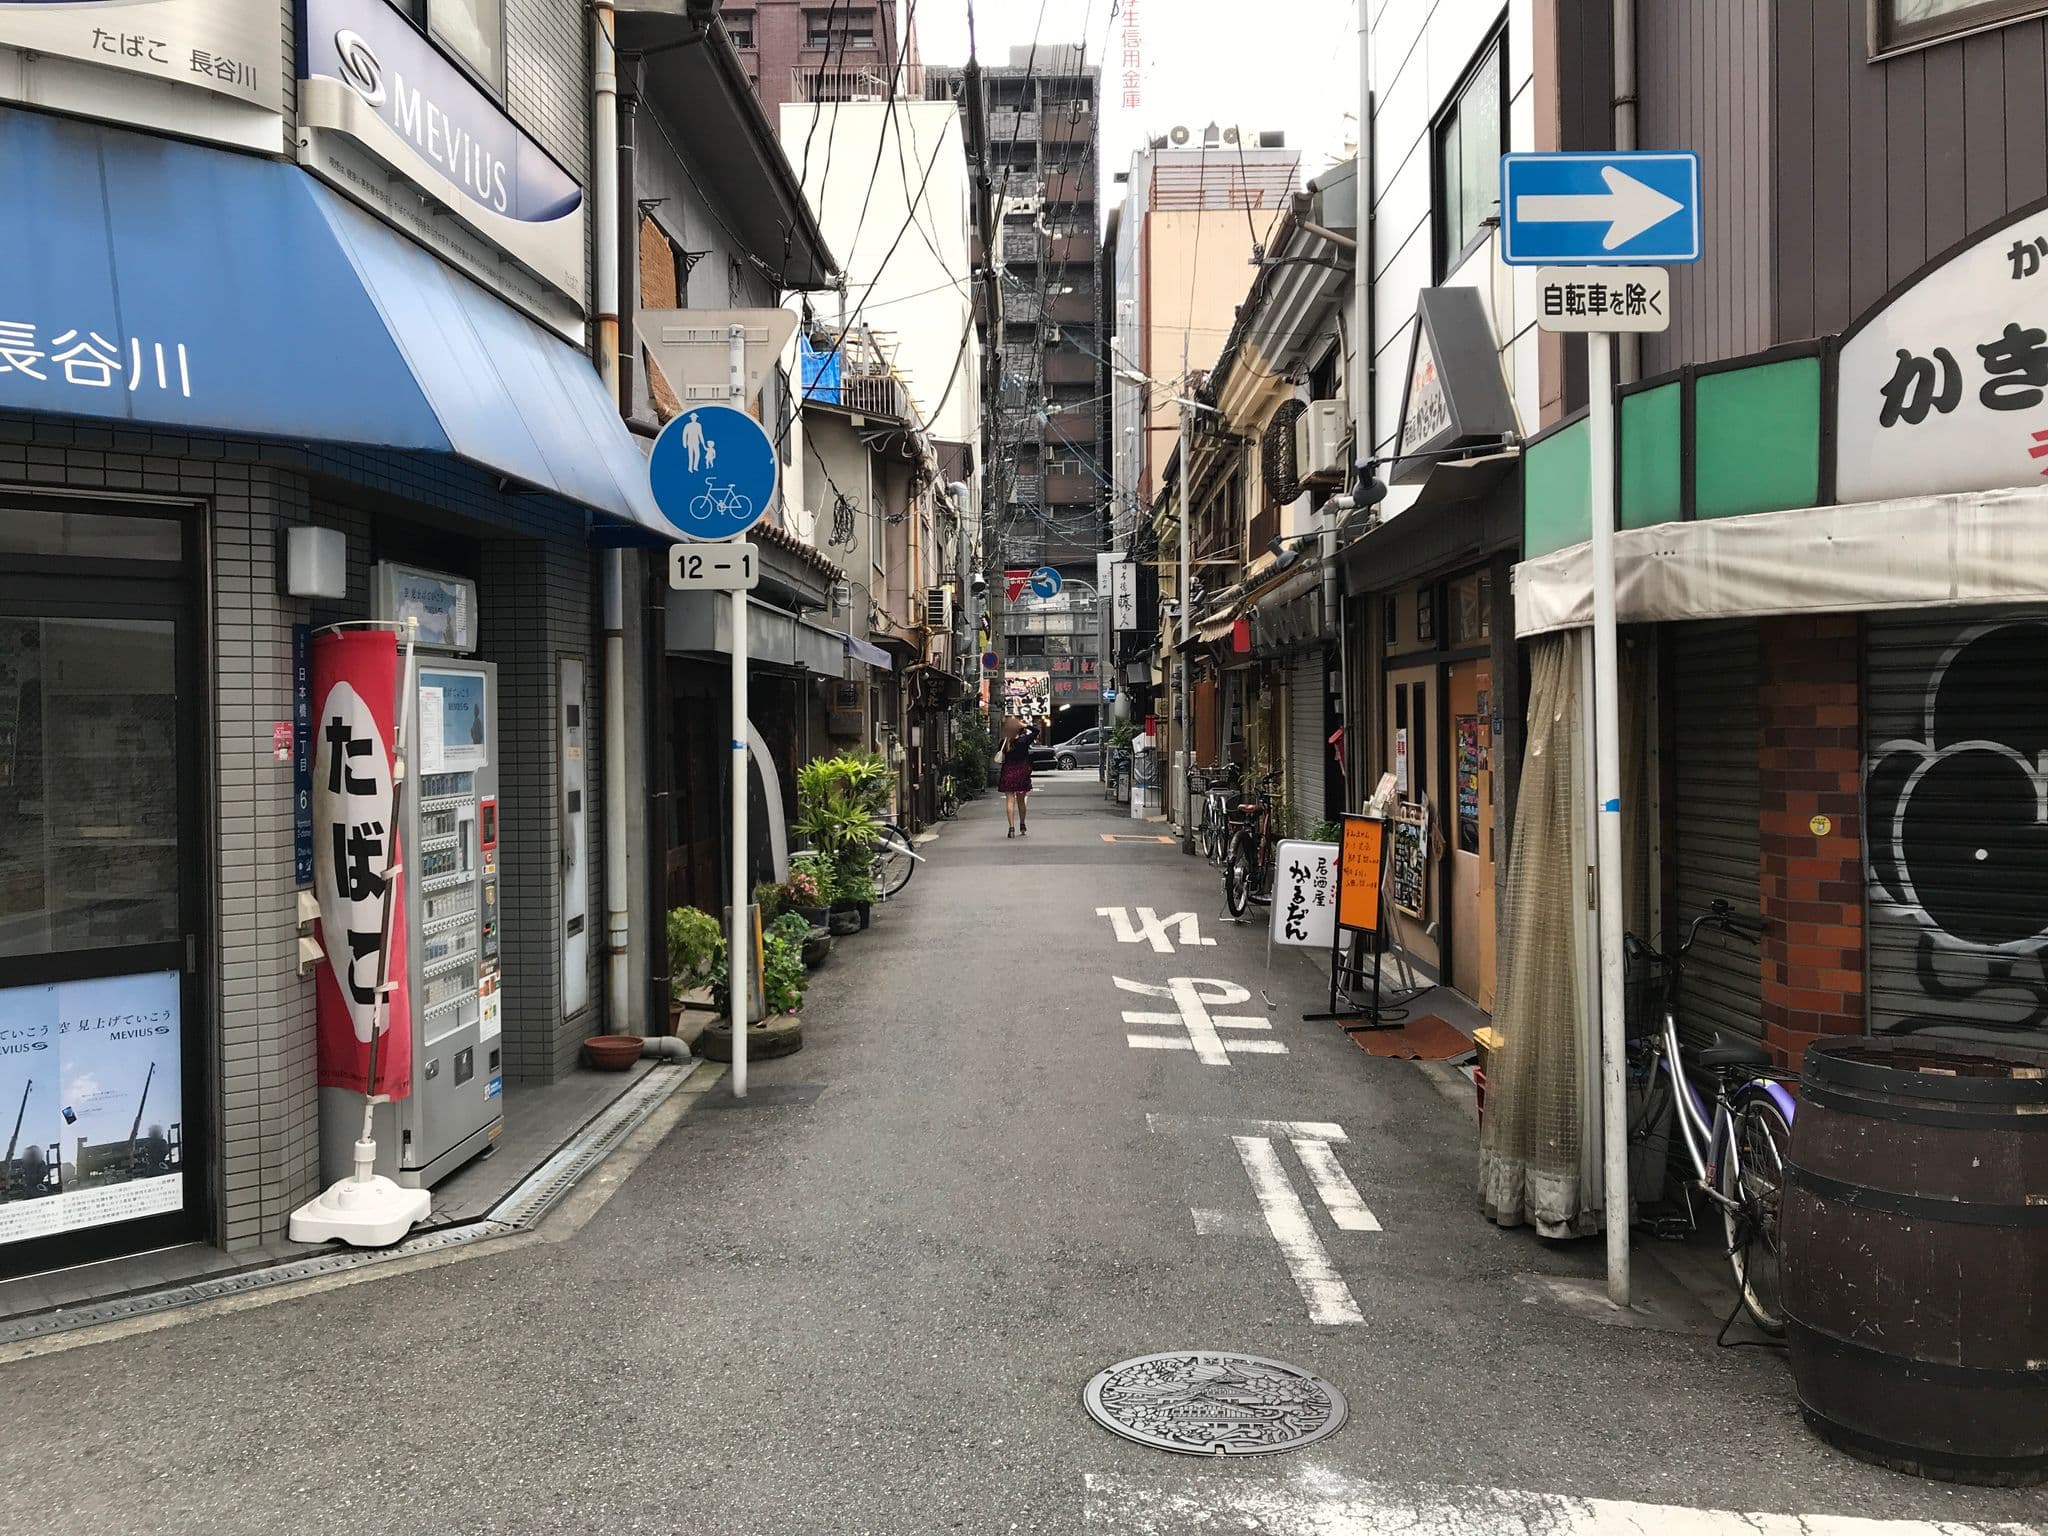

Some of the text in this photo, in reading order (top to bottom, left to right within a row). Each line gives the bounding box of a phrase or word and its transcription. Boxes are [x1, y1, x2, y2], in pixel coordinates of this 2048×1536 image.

[92, 28, 257, 91] たばこ 長谷川
[394, 71, 507, 213] MEVIUS
[1544, 282, 1662, 316] 自転車を除く
[0, 320, 191, 397] 長谷川
[1879, 322, 2048, 428] かき
[298, 667, 308, 773] 日本橋二丁目
[300, 790, 308, 809] 6
[325, 716, 390, 1005] たばこ
[1312, 857, 1328, 907] 居酒屋
[58, 1010, 171, 1034] 空 見上げていこう
[110, 1028, 153, 1041] MEVIUS
